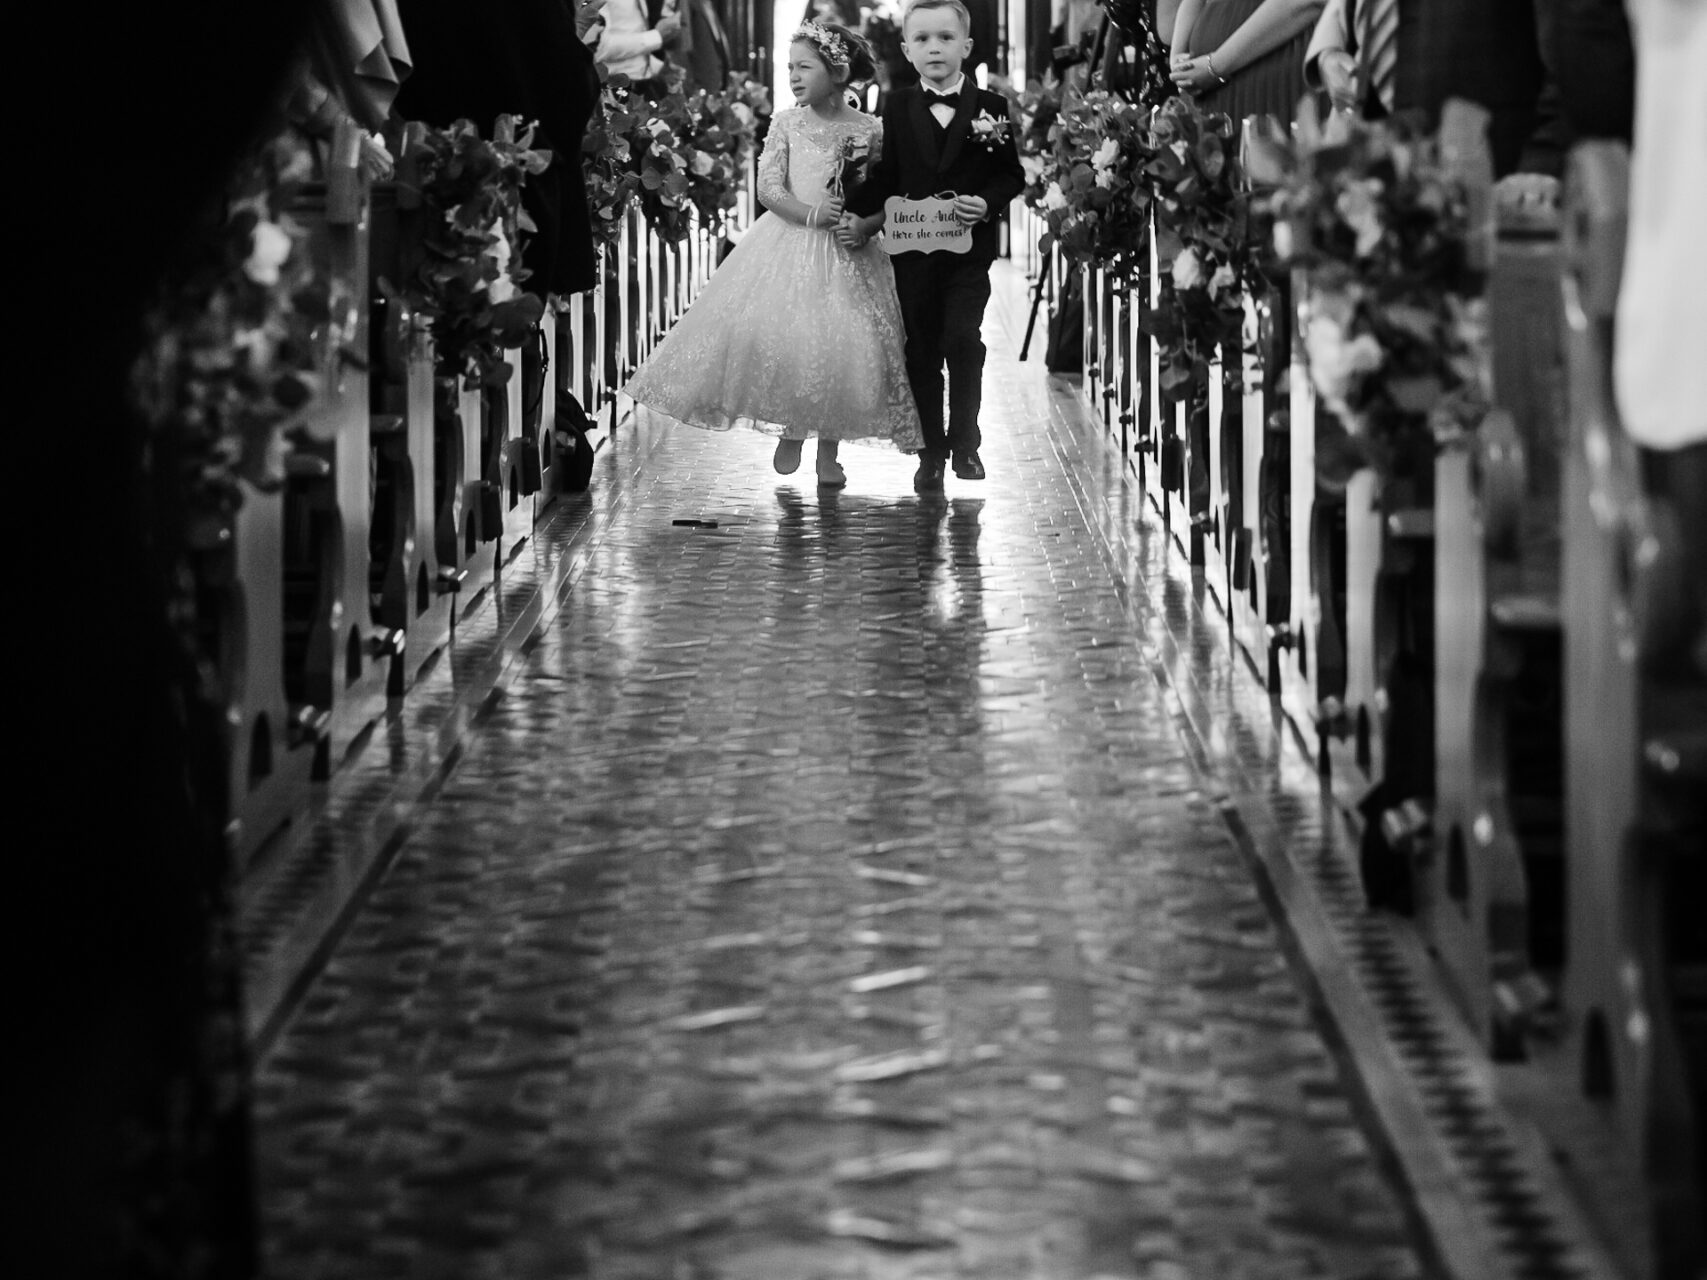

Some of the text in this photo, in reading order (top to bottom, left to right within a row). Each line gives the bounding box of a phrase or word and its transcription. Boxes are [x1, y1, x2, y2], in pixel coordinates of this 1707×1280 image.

[894, 210, 926, 223] Uncle
[893, 230, 913, 239] Here
[917, 228, 931, 239] she
